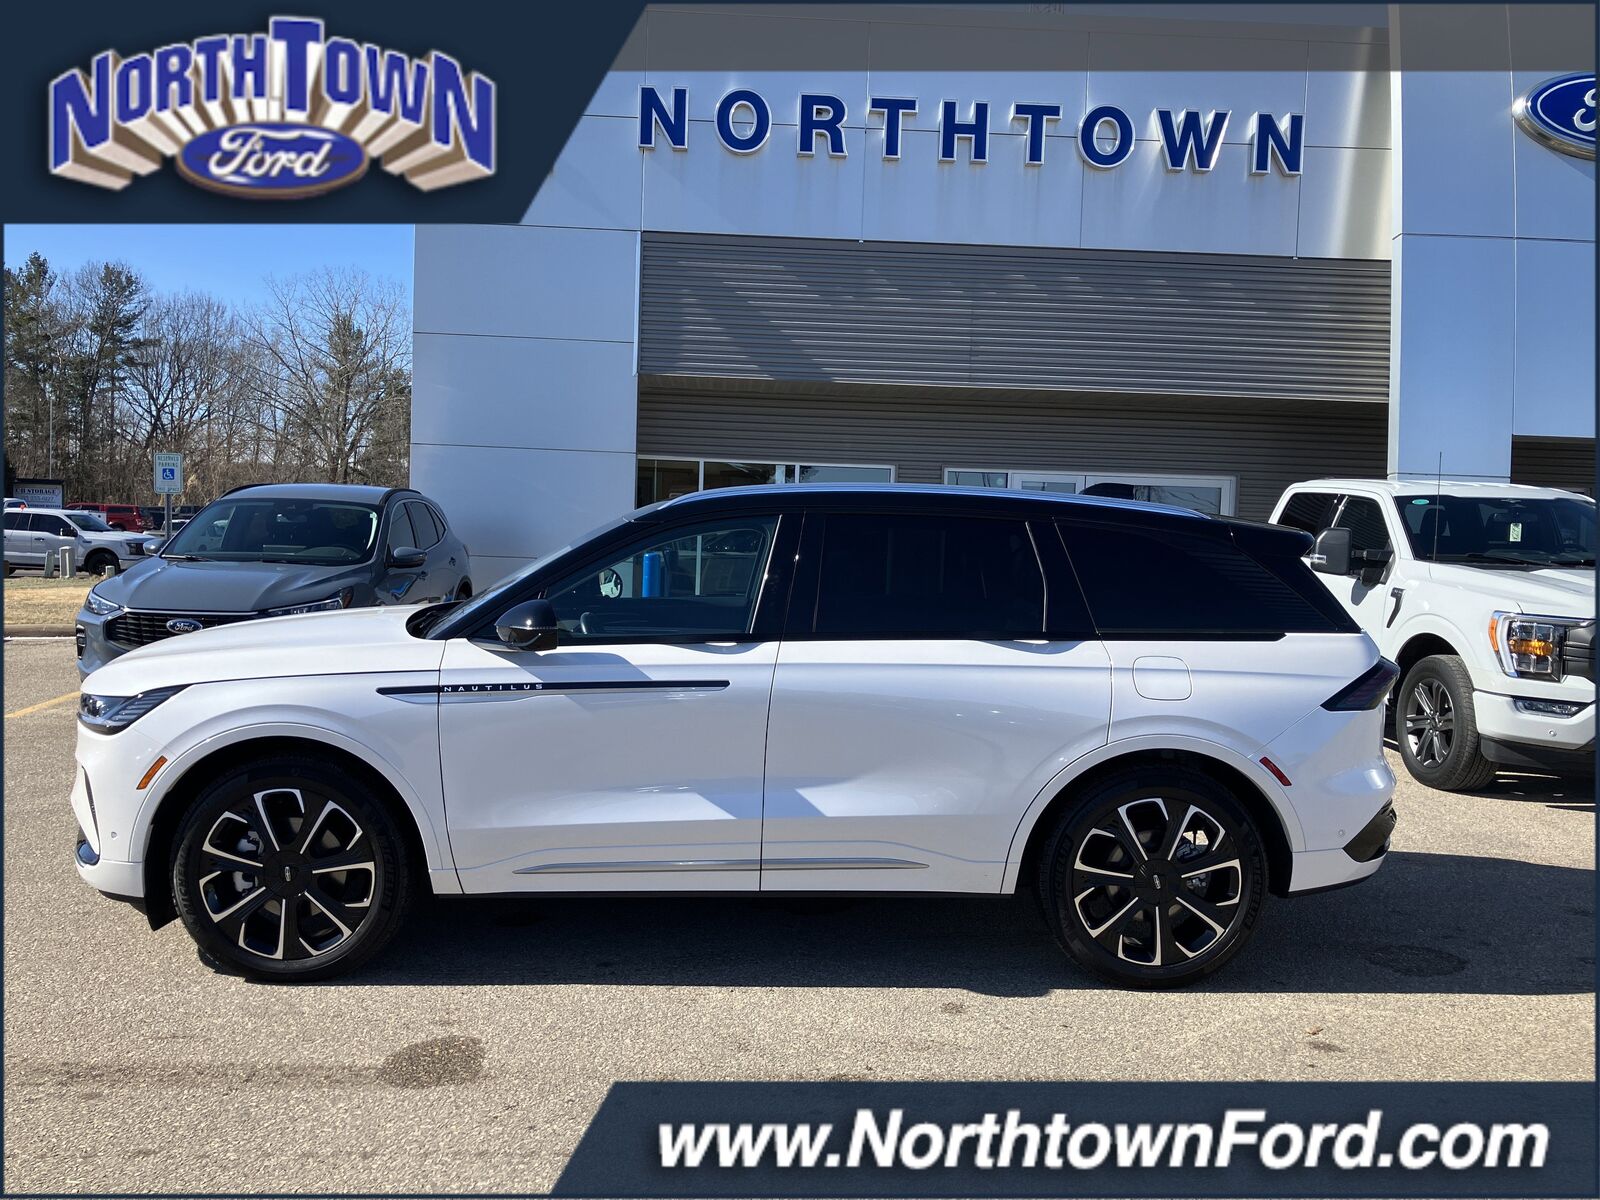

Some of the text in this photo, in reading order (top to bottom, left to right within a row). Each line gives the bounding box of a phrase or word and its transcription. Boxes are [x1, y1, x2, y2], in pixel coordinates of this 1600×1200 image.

[638, 84, 1306, 177] NORTHTOWN
[174, 622, 195, 632] Ford
[443, 683, 543, 693] NAUTILUS
